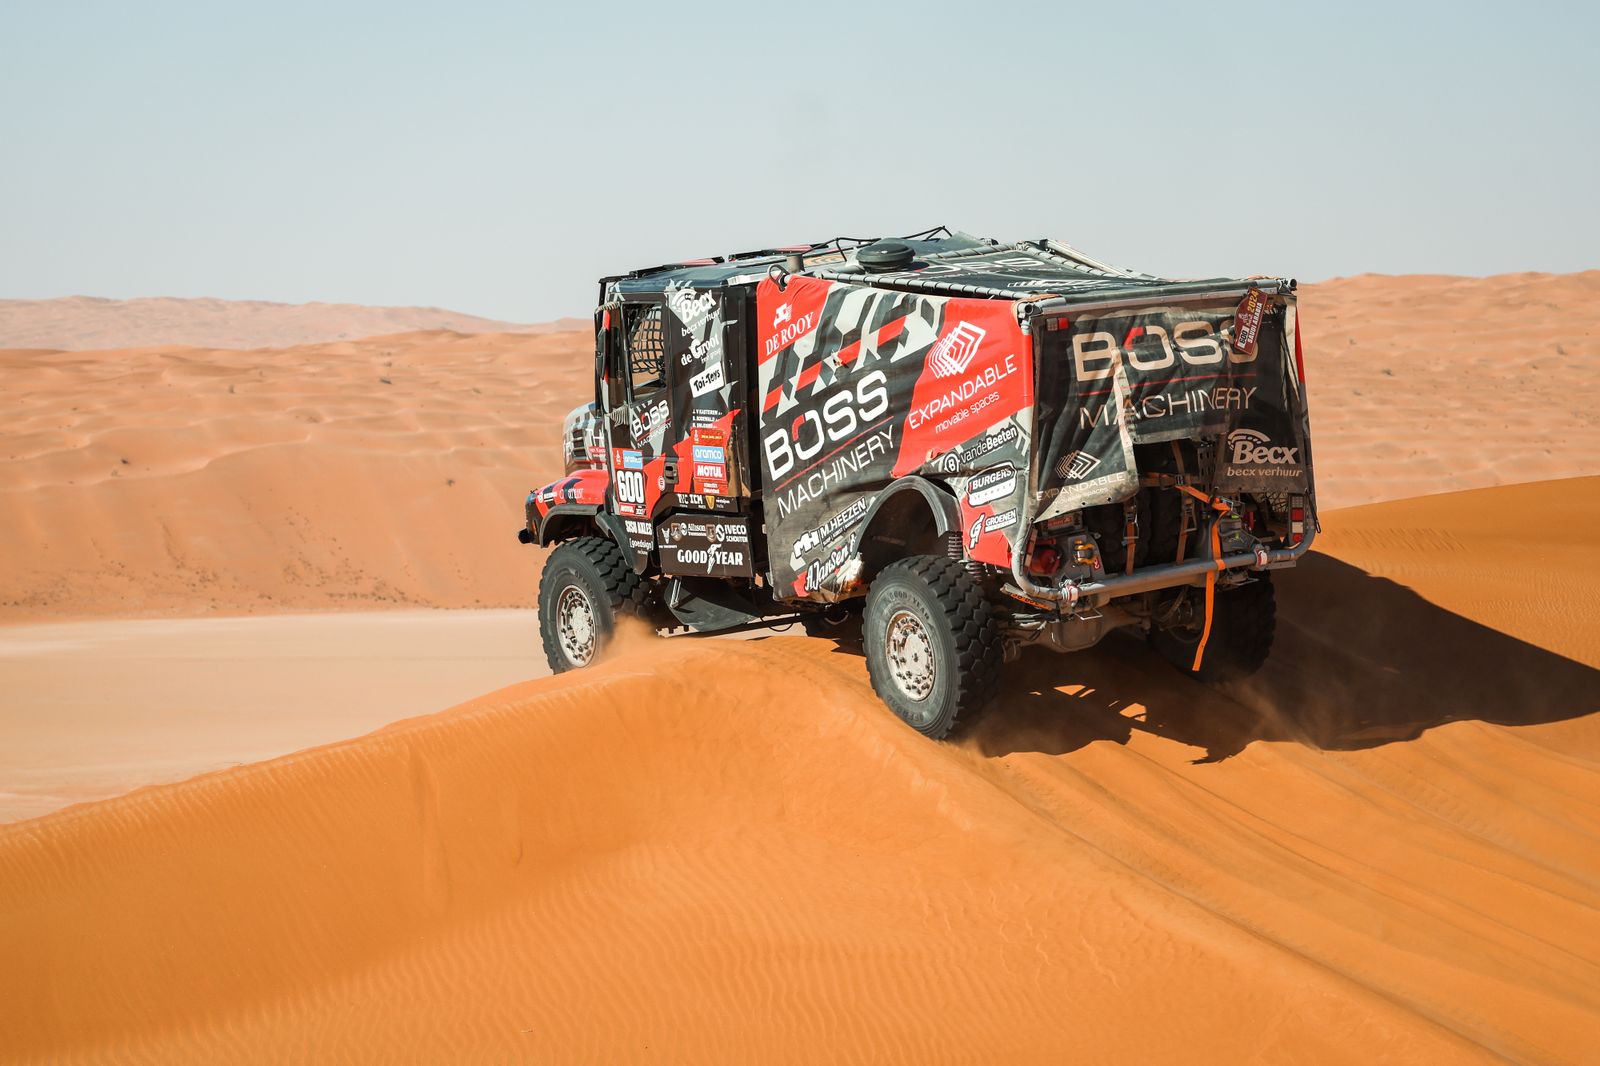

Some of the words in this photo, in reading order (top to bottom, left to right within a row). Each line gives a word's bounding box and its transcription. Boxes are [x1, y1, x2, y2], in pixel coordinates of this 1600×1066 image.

[680, 289, 716, 324] Becx
[1247, 289, 1259, 313] 2024
[765, 334, 780, 356] DE
[780, 311, 814, 342] ROOY
[1247, 324, 1257, 344] SAUDI
[1252, 302, 1263, 326] ARABIA
[680, 353, 692, 366] de
[689, 334, 719, 359] Groot
[908, 353, 1018, 430] EXPANDABLE
[633, 400, 670, 438] BOSS
[764, 370, 889, 482] BOSS
[935, 408, 969, 434] movable
[969, 391, 1000, 418] spaces
[637, 421, 673, 449] MACHINERY
[960, 426, 1018, 463] vandeBeeten
[695, 448, 722, 460] aramco
[1232, 440, 1298, 465] Becx
[616, 470, 645, 504] 600
[697, 465, 723, 478] MOTUL
[777, 425, 895, 519] MACHINERY
[972, 468, 1012, 490] BURGERS
[1036, 472, 1126, 501] EXPANDABLE
[1227, 466, 1255, 477] becx
[1257, 466, 1303, 477] verhuur
[724, 524, 747, 535] IVECO
[985, 510, 1016, 527] GROENEN
